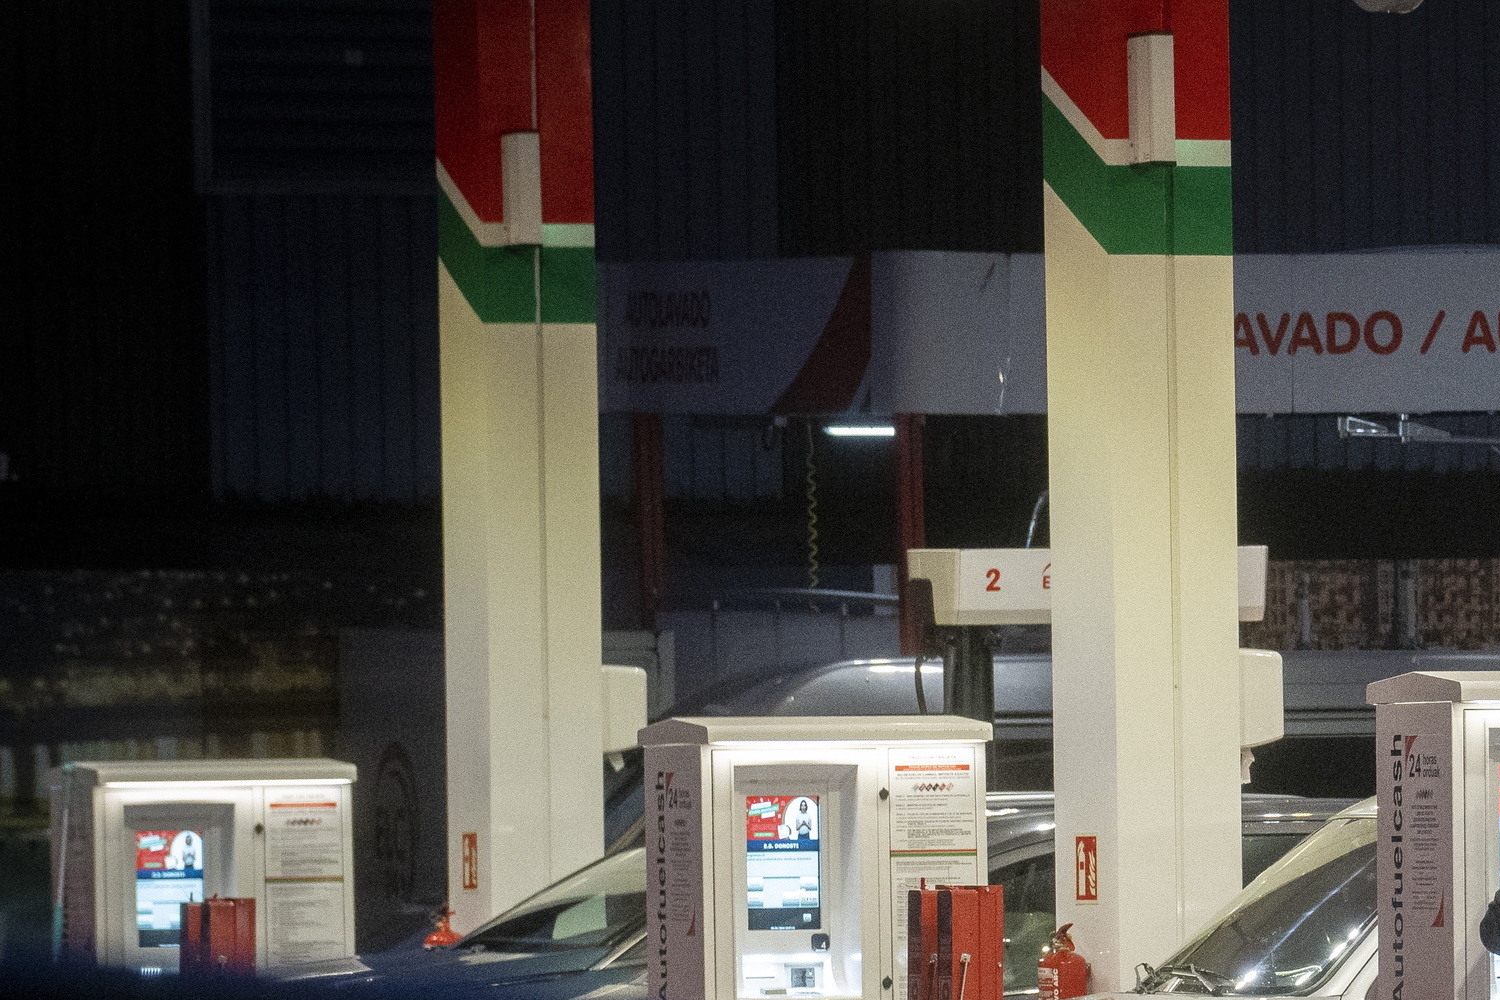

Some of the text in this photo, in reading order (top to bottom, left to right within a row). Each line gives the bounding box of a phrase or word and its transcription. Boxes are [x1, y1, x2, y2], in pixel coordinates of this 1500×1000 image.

[1233, 310, 1403, 356] AVADO
[985, 567, 1001, 592] 2
[1409, 754, 1422, 778] 24
[820, 941, 827, 950] 4
